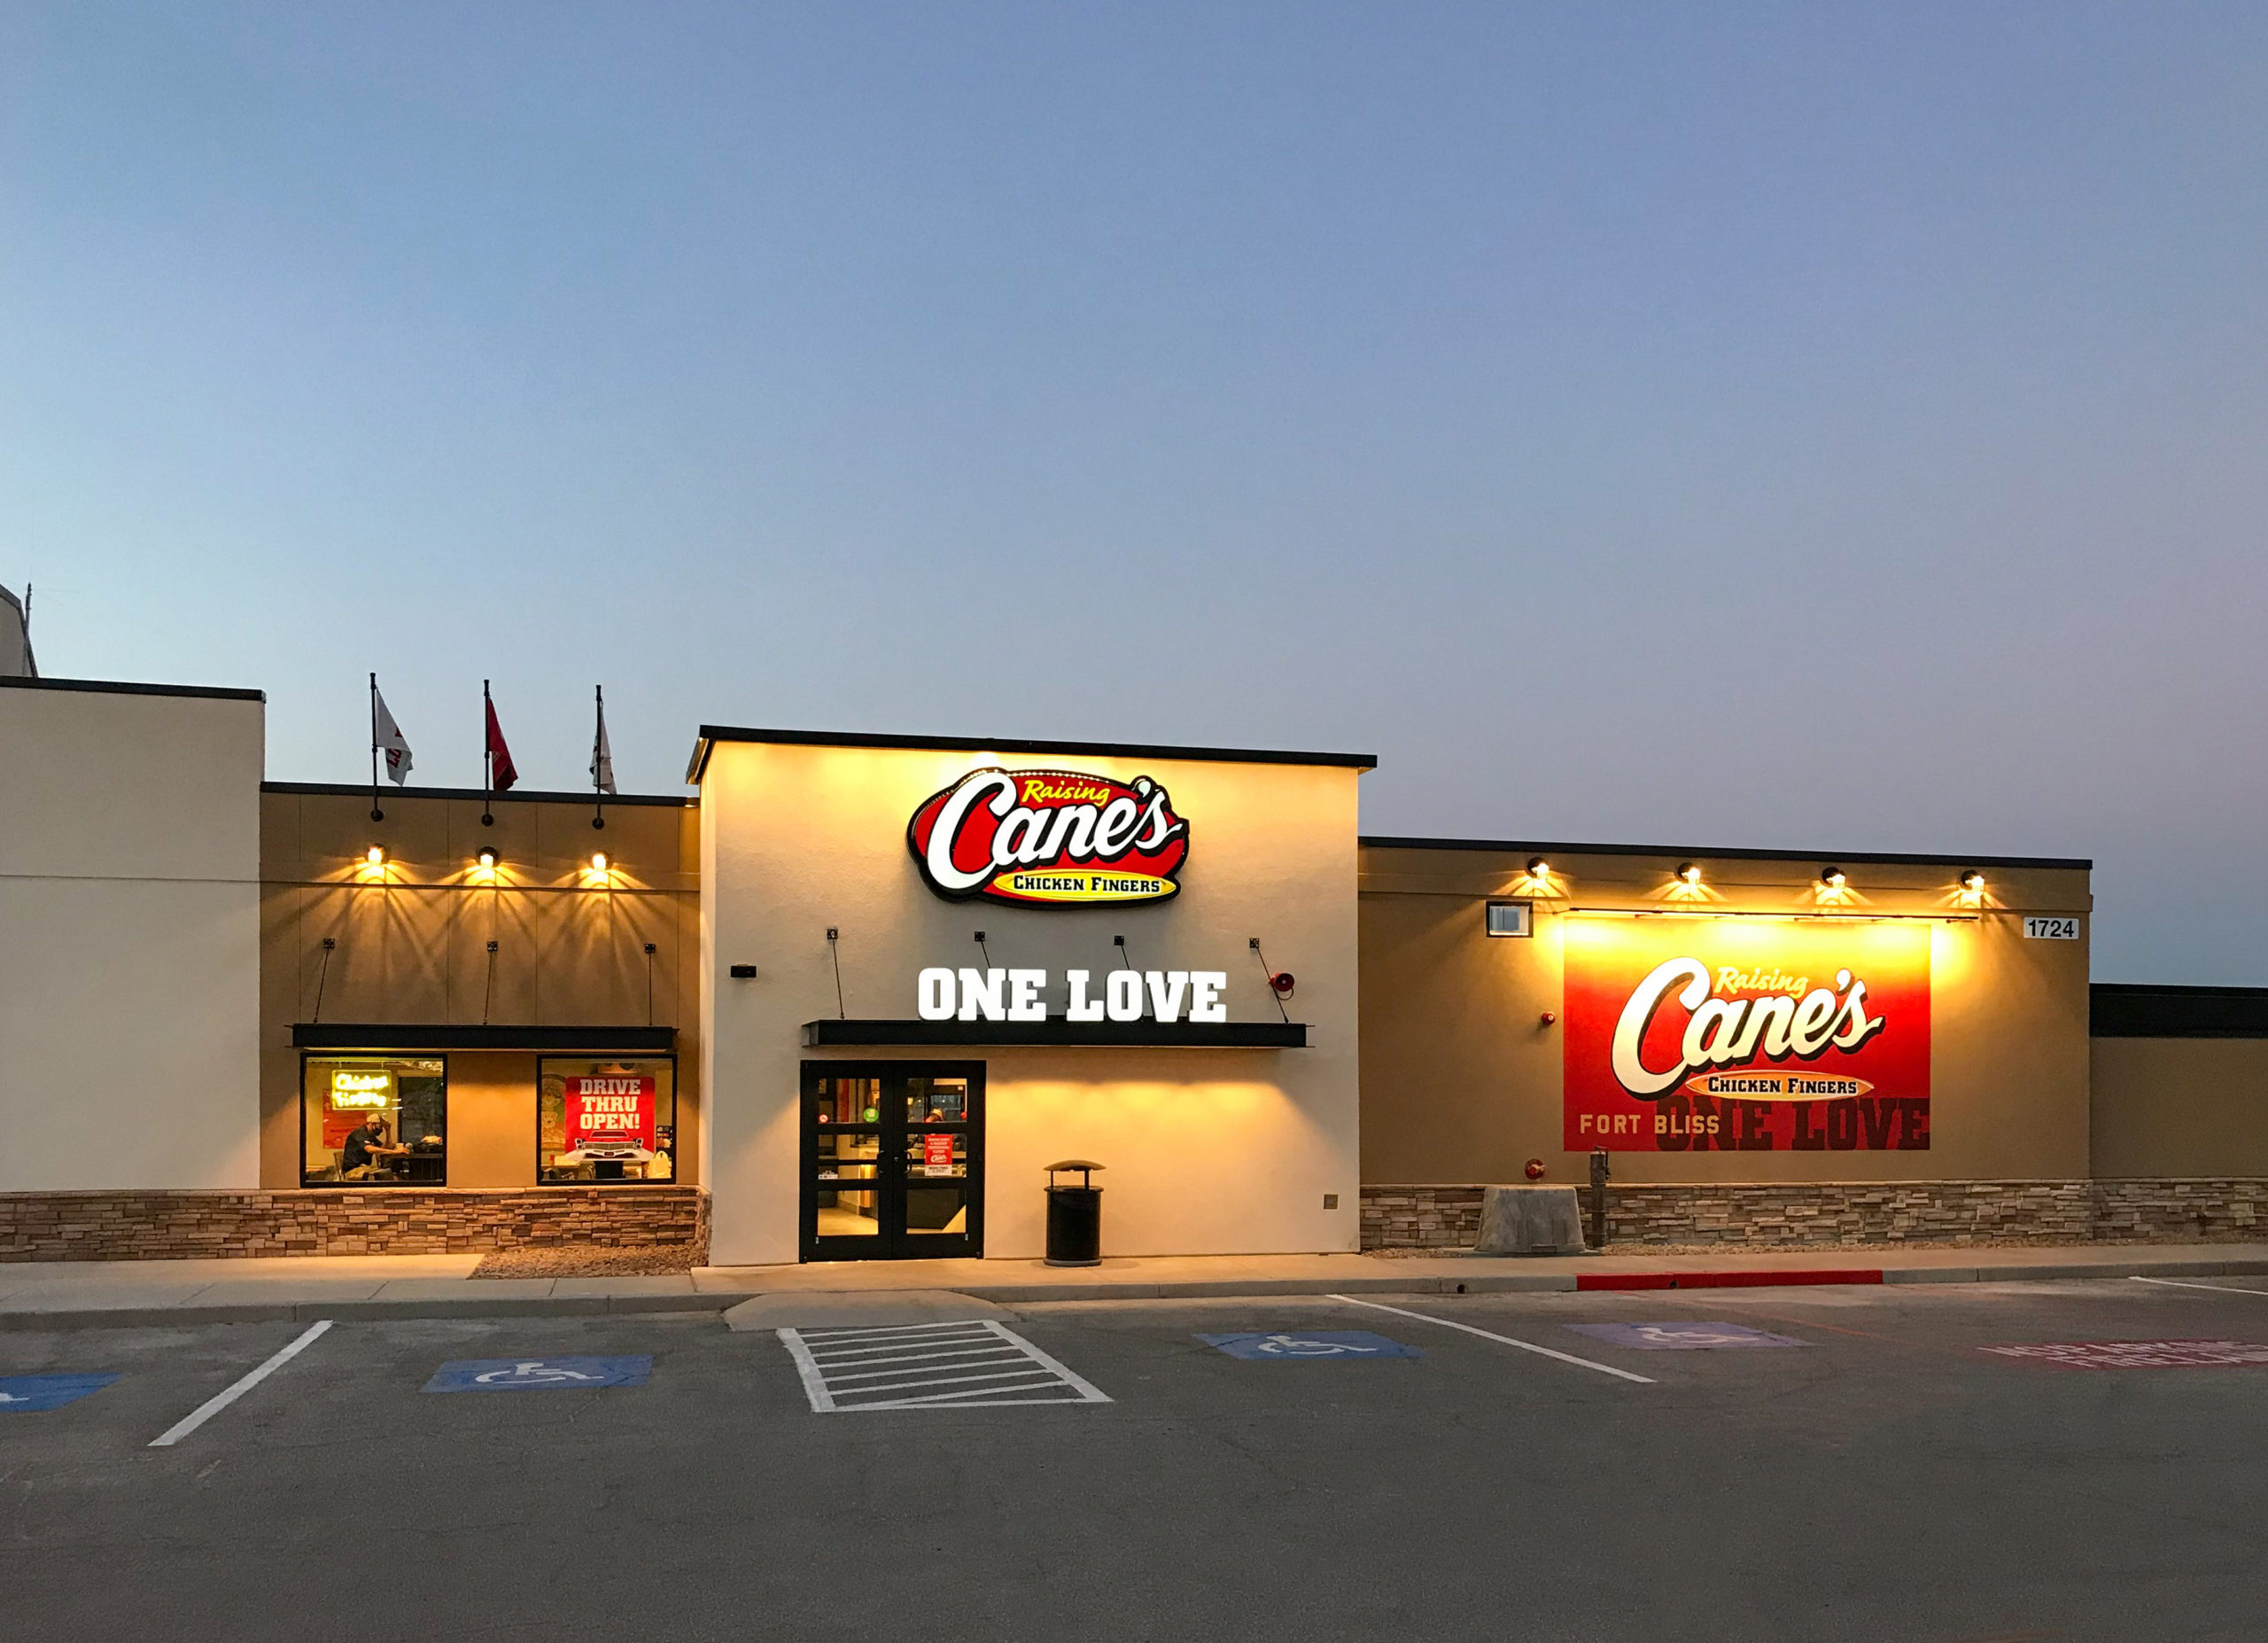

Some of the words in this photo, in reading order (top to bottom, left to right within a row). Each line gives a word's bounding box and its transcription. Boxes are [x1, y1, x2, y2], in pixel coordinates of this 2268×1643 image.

[1021, 779, 1110, 807] Raising
[927, 772, 1183, 890] Cane's
[1014, 875, 1084, 891] CHICKEN
[1091, 876, 1160, 892] FINGERS
[2028, 919, 2075, 938] 1724
[1713, 966, 1808, 999] Raising
[918, 967, 1046, 1022] ONE
[1066, 969, 1227, 1023] LOVE
[1612, 955, 1884, 1095] Cane's
[579, 1078, 641, 1095] DRIVE
[1708, 1076, 1781, 1093] CHICKEN
[1787, 1078, 1857, 1094] FINGERS
[581, 1095, 638, 1112] THRU
[579, 1113, 641, 1130] OPEN!
[1580, 1114, 1641, 1134] FORT
[1654, 1114, 1720, 1134] BLISS
[1656, 1094, 1774, 1152] ONE
[1791, 1096, 1930, 1151] LOVE
